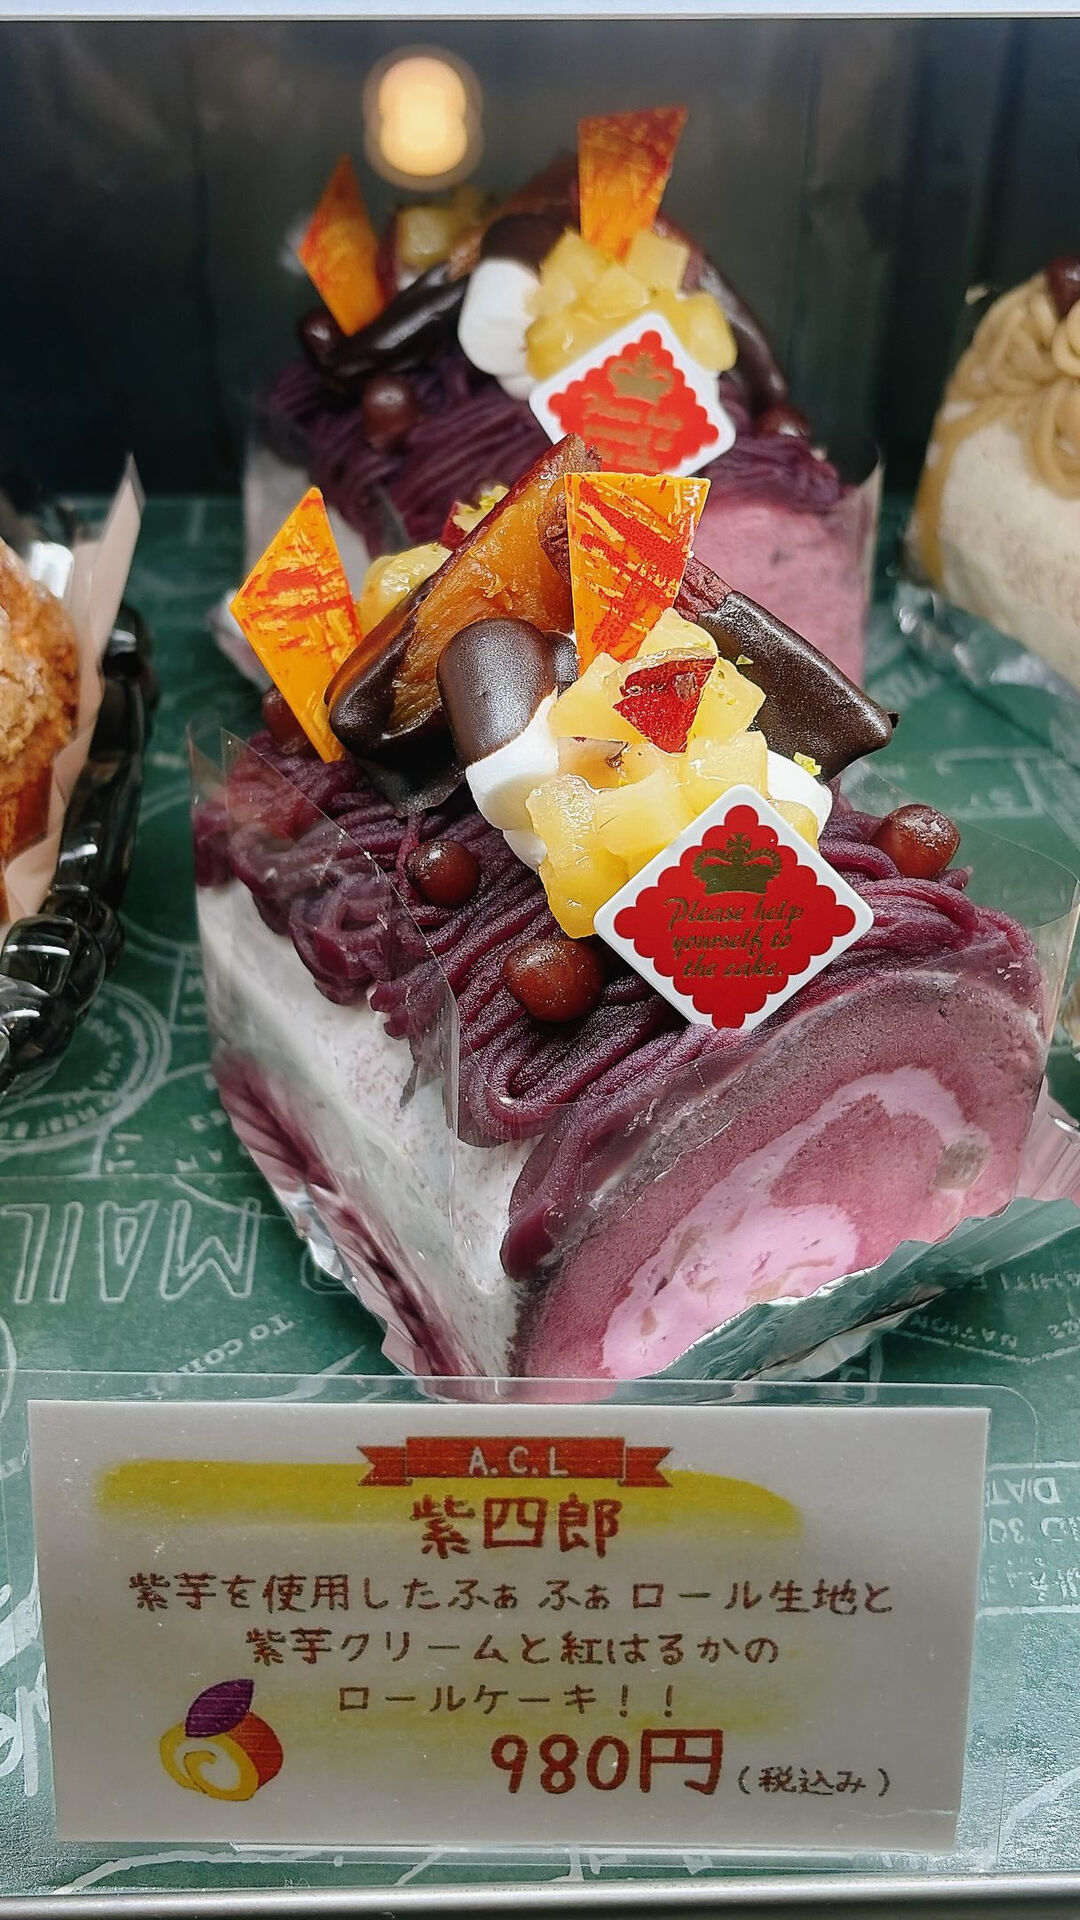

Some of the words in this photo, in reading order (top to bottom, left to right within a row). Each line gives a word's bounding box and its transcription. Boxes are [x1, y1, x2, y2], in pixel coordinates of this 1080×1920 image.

[664, 897, 746, 931] Please
[752, 897, 804, 930] help
[671, 925, 763, 959] yourself
[769, 927, 793, 949] to
[682, 954, 717, 978] the
[723, 954, 783, 978] cake.
[0, 1197, 261, 1304] MAIL
[248, 1313, 296, 1341] TO
[468, 1445, 570, 1477] A.C.L
[409, 1492, 624, 1560] 紫四郎
[244, 1626, 780, 1667] 紫芋クリームと紅はるかの
[490, 1727, 724, 1796] 980円
[736, 1764, 891, 1798] （税込み）
